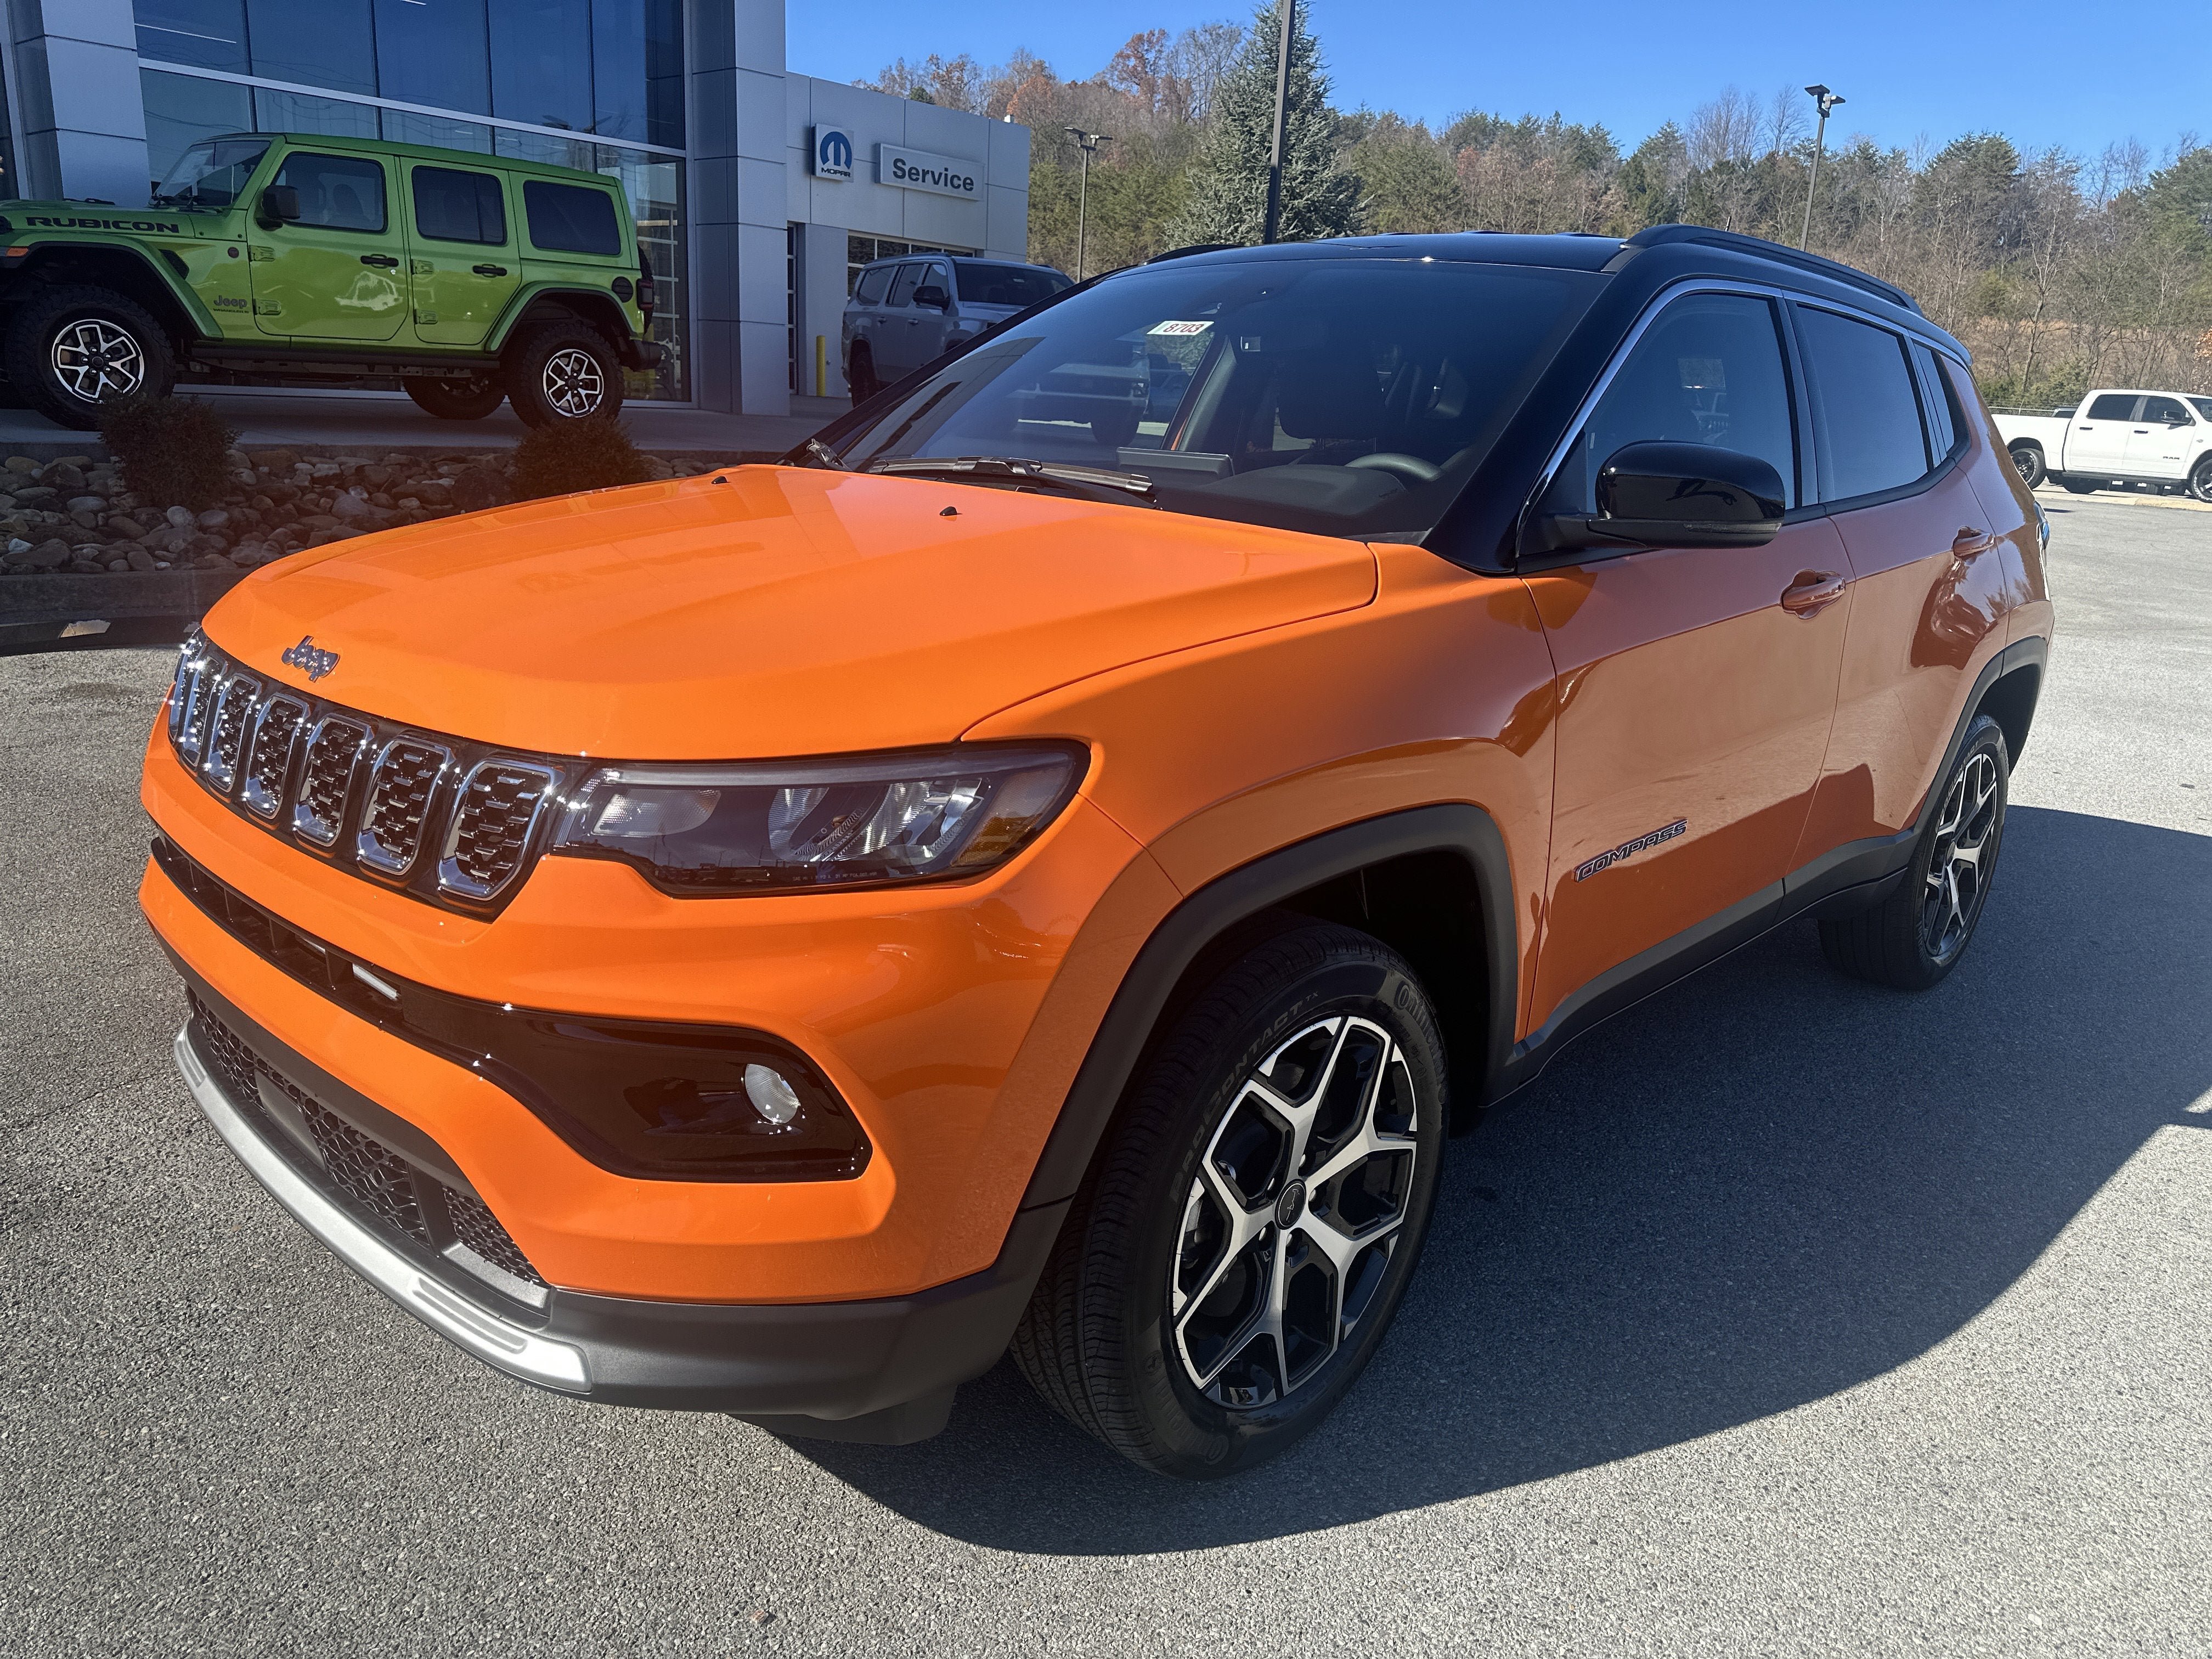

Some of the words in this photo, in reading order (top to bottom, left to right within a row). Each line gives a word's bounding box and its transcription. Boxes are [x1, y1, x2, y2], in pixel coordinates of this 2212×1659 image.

[821, 167, 851, 177] MOPAR
[893, 158, 974, 191] Service
[25, 217, 179, 233] RUBICON
[213, 295, 247, 309] Jeep
[1163, 323, 1205, 332] 8703
[281, 635, 340, 683] Jeep
[1574, 818, 1689, 883] COMPASS
